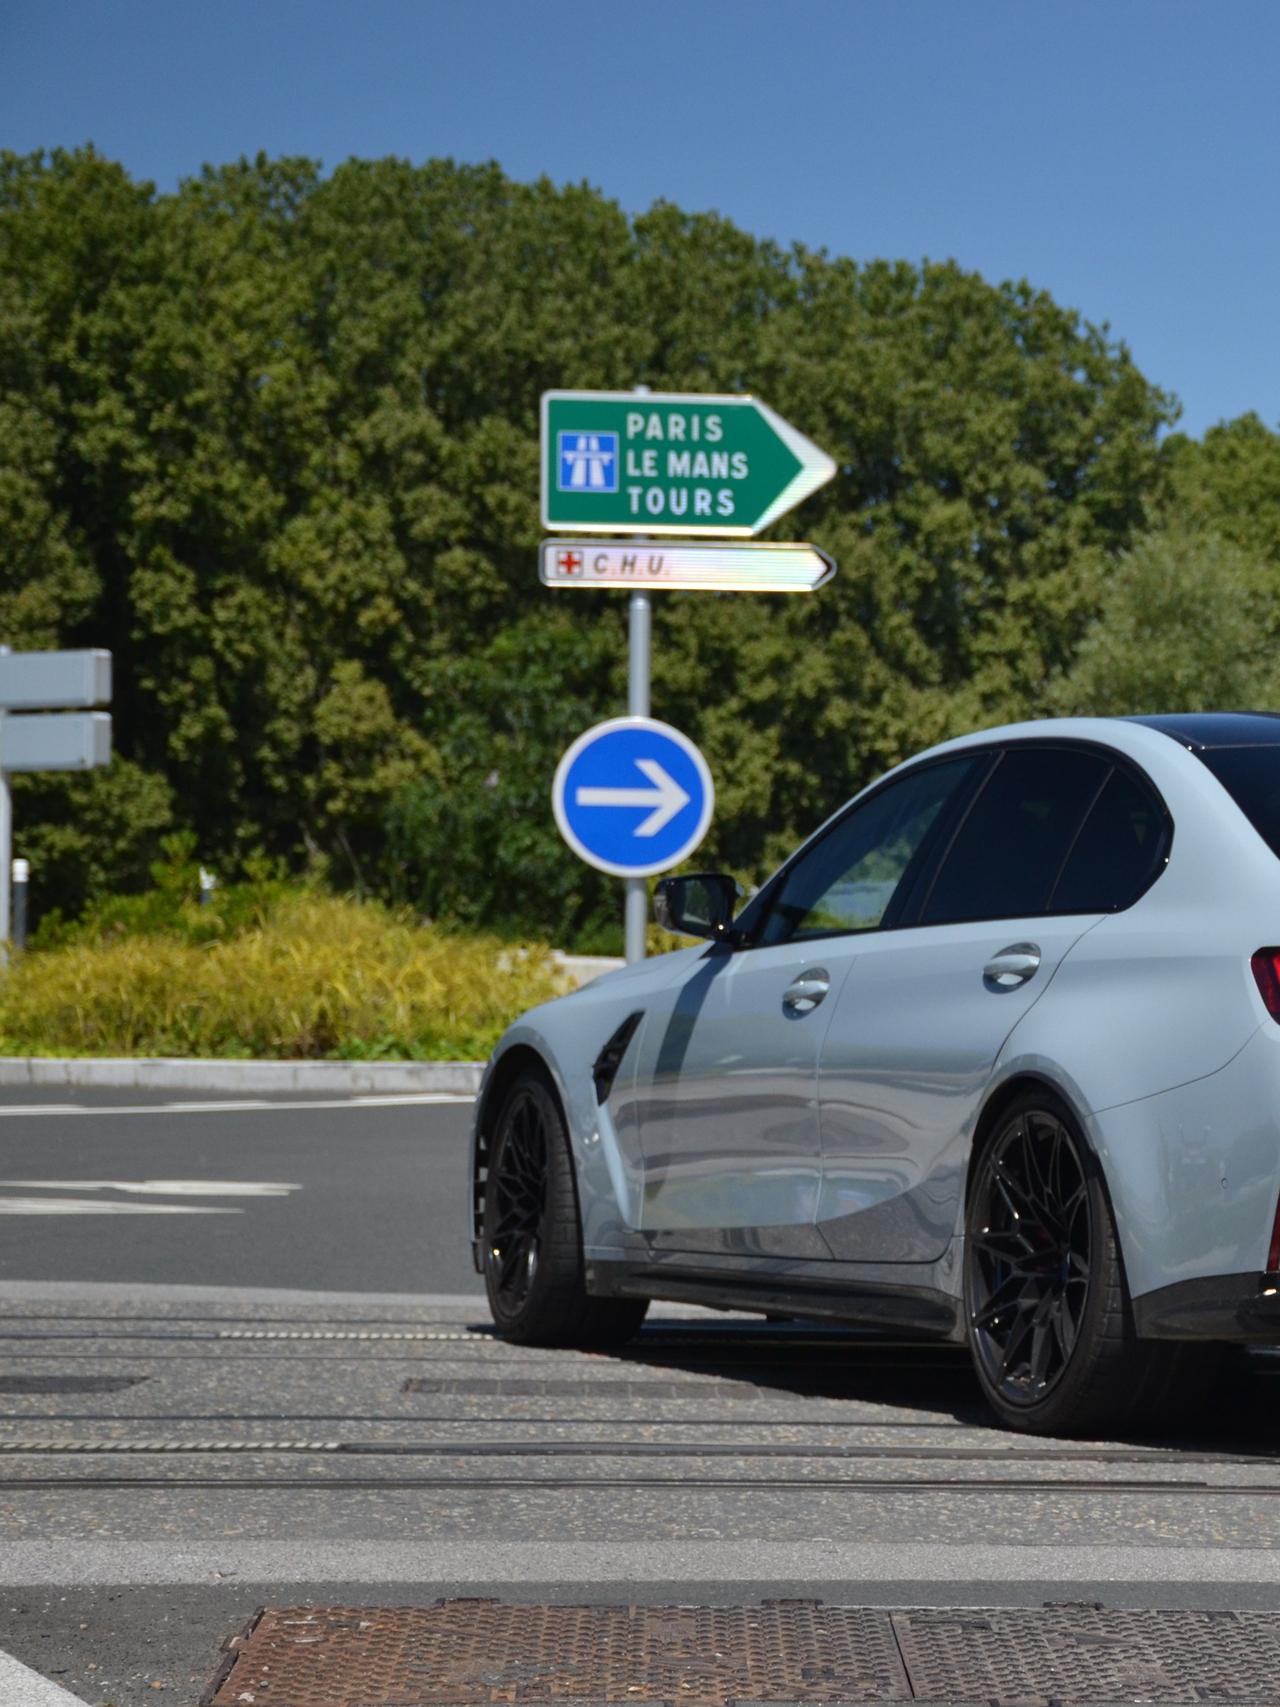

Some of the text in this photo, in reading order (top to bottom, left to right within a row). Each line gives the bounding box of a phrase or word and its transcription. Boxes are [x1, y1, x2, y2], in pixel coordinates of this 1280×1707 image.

[627, 412, 723, 442] PARIS
[627, 450, 749, 480] LE MANS
[627, 487, 735, 517] TOURS
